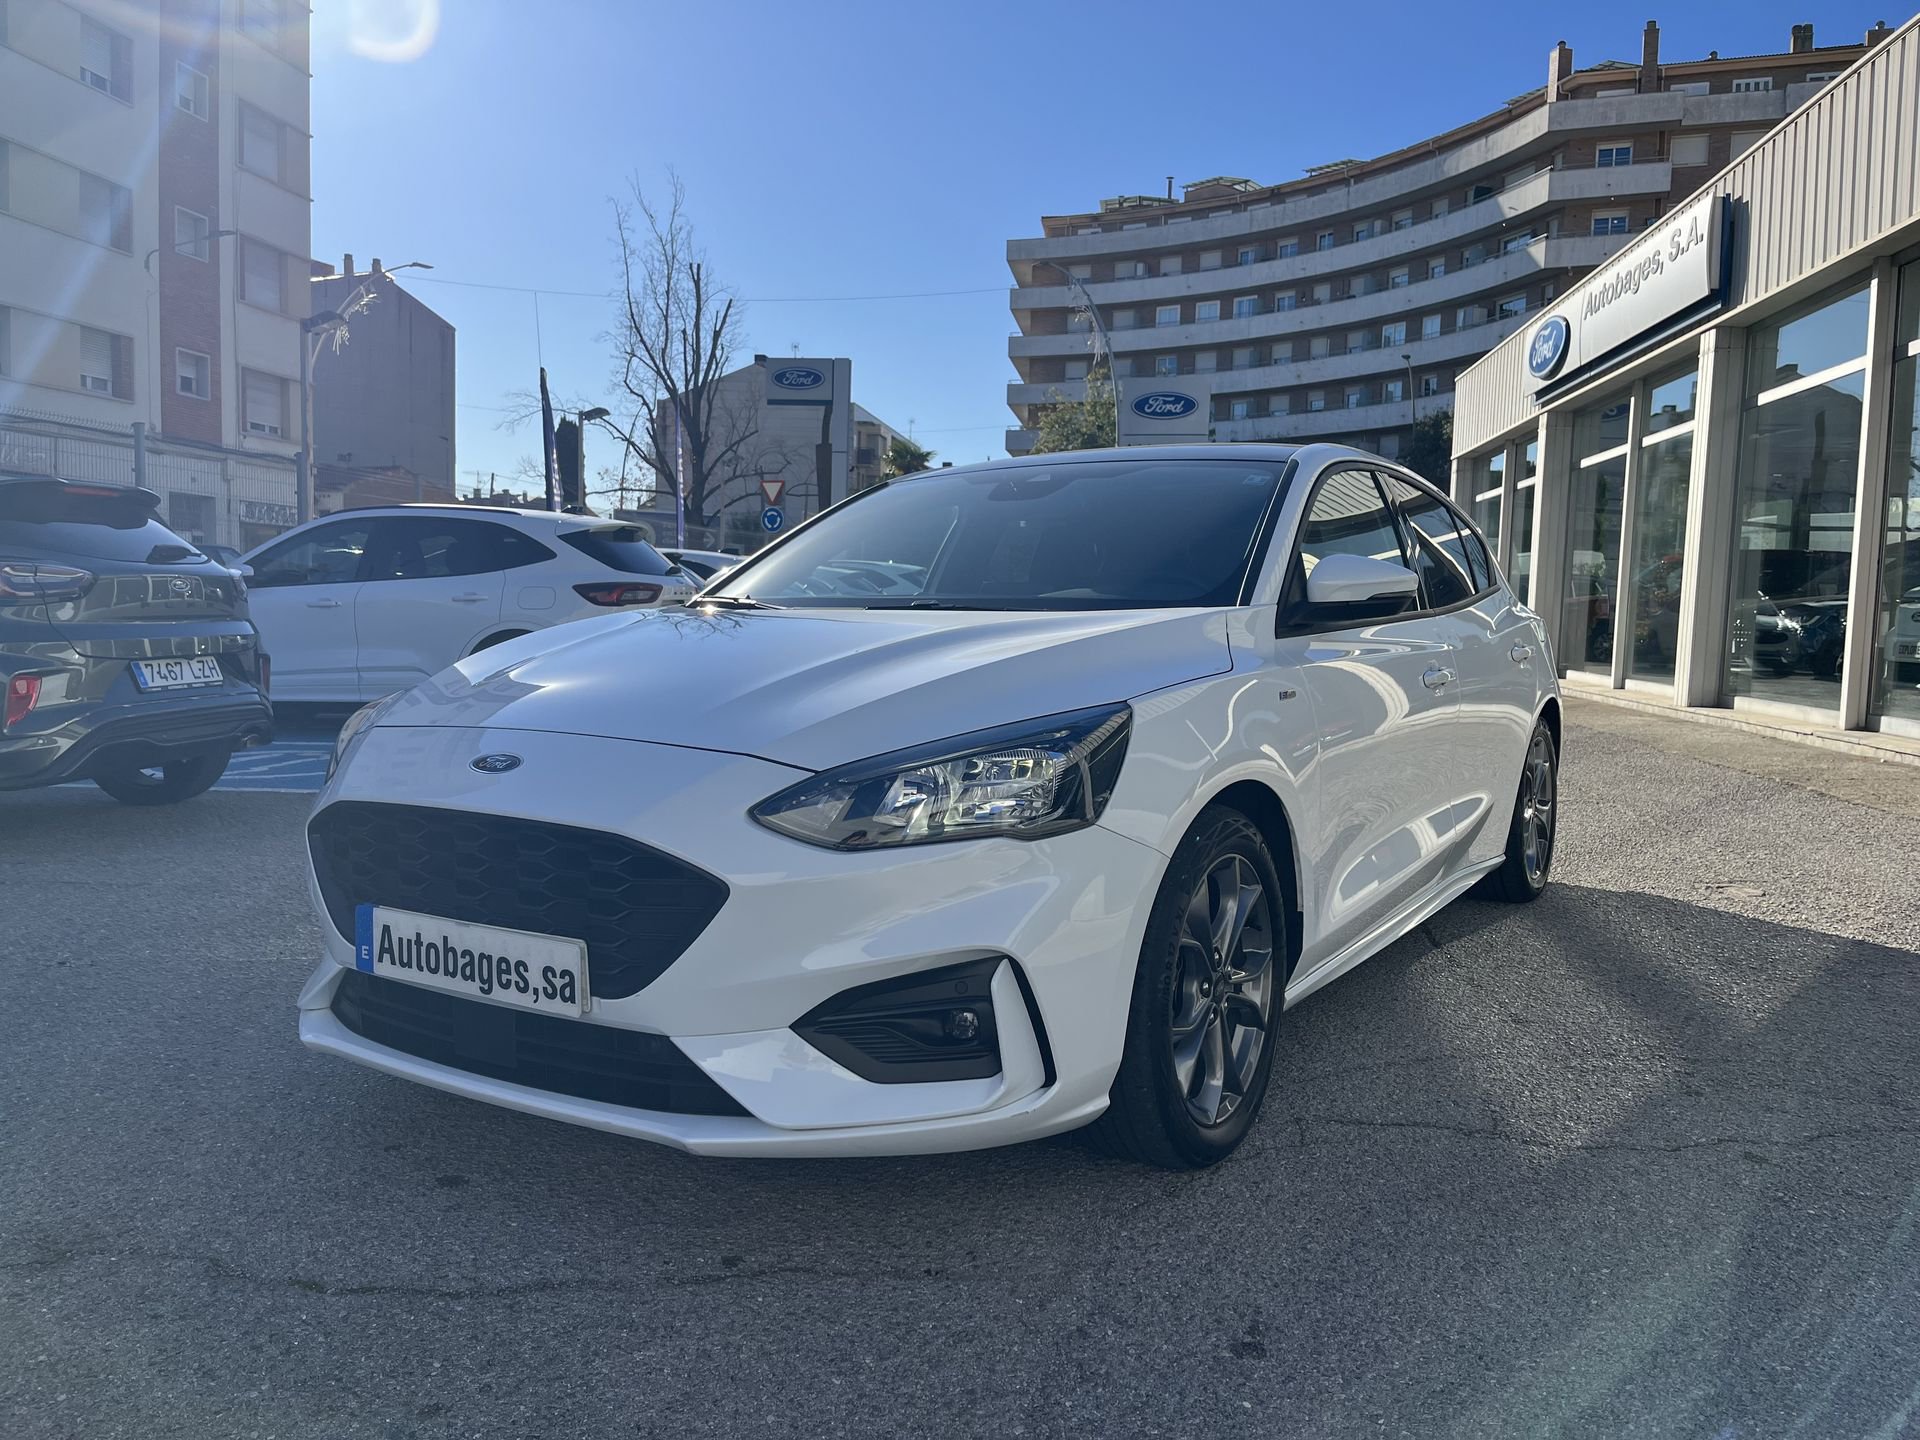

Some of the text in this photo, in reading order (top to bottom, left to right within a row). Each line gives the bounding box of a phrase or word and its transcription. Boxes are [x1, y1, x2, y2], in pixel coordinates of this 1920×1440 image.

[1583, 216, 1704, 320] Autobages, S.A.
[1532, 327, 1557, 368] Ford
[782, 371, 814, 385] Ford
[1144, 396, 1185, 413] Ford
[144, 659, 219, 683] 7467 LZH
[361, 945, 370, 960] E
[377, 923, 577, 1005] Autobages,sa
